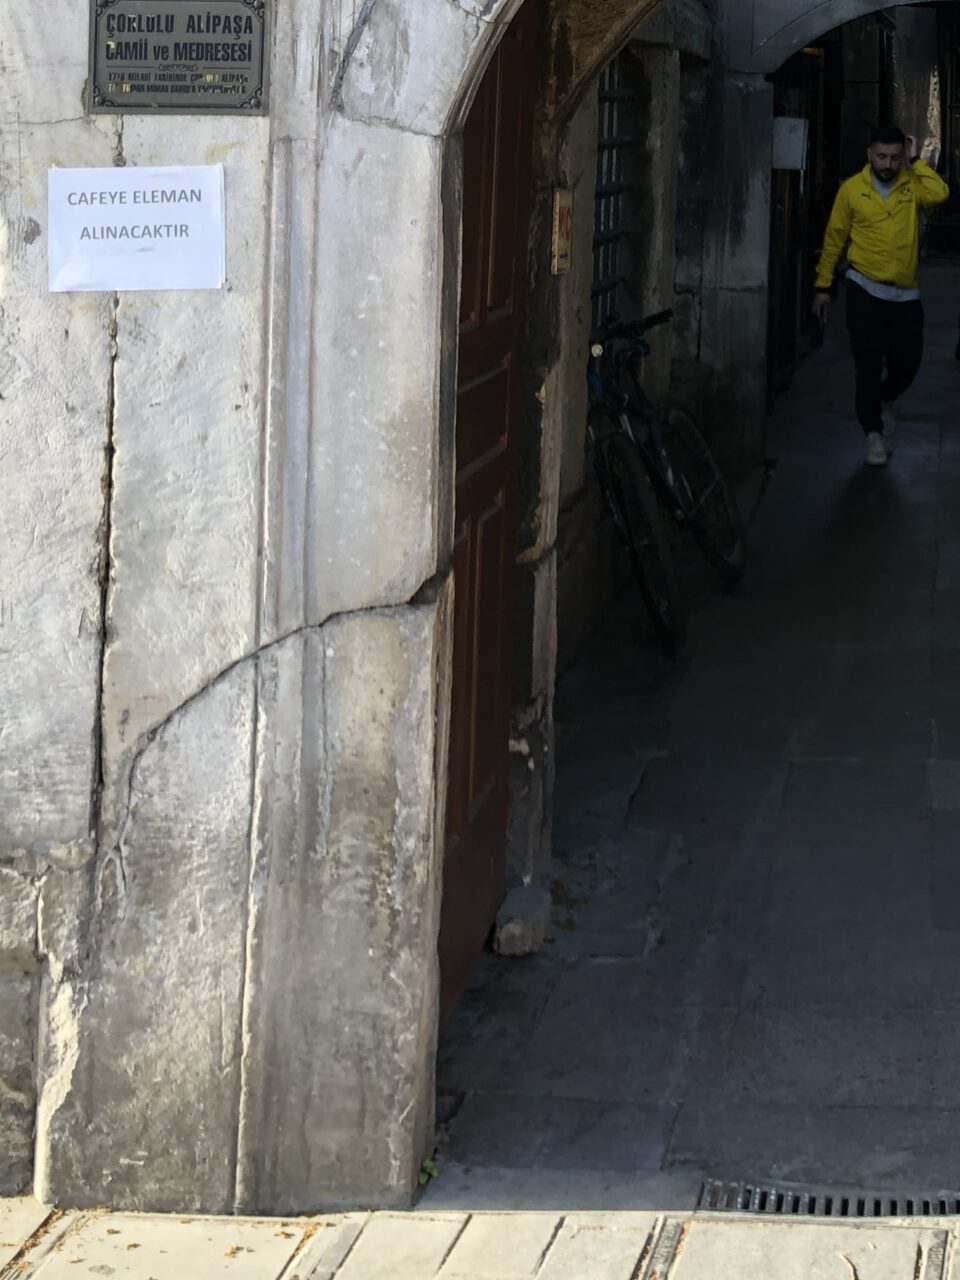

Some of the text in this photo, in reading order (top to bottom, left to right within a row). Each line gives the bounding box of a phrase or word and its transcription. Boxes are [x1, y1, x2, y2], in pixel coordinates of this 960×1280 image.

[106, 11, 253, 40] ÇORLULU ALİPAŞA
[105, 38, 252, 62] CAMİİ ve MEDRESESİ
[67, 189, 202, 206] CAFEYE ELEMAN
[80, 224, 189, 240] ALINACAKTIR
